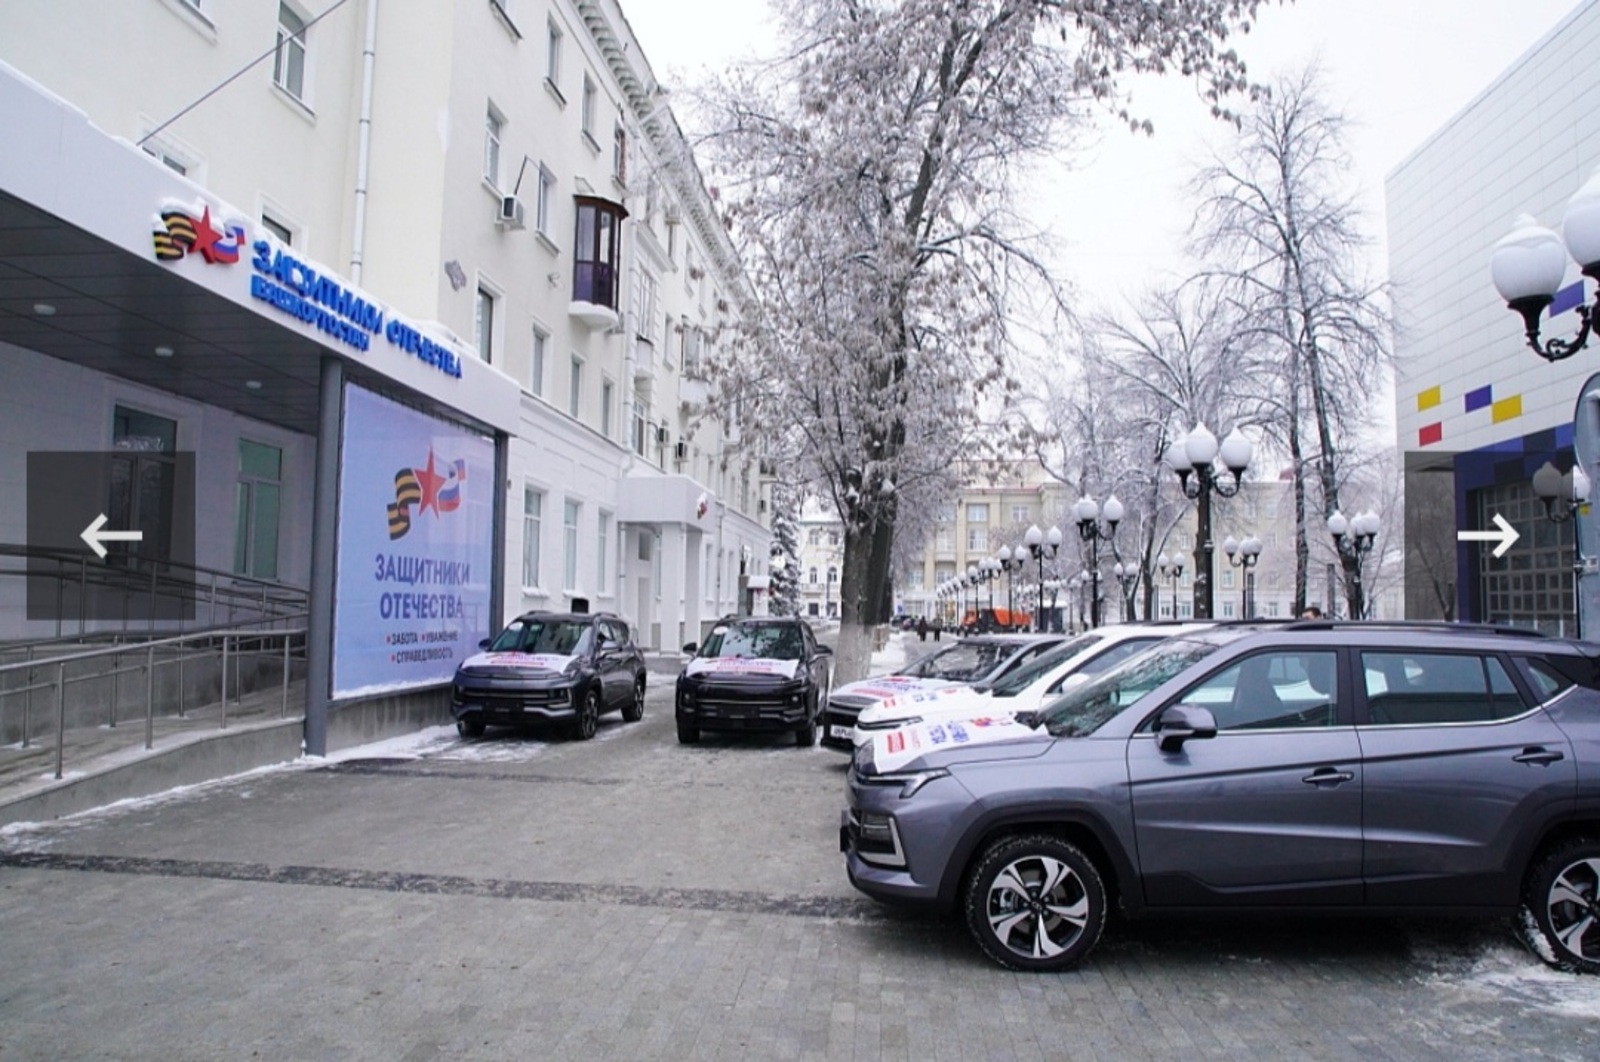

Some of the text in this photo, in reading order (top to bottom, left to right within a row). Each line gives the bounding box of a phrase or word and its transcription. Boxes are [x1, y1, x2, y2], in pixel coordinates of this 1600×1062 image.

[375, 553, 470, 585] ЗАЩИТНИКИ
[380, 592, 463, 620] ОТЕЧЕСТВА
[391, 632, 418, 645] ЗАБОТА
